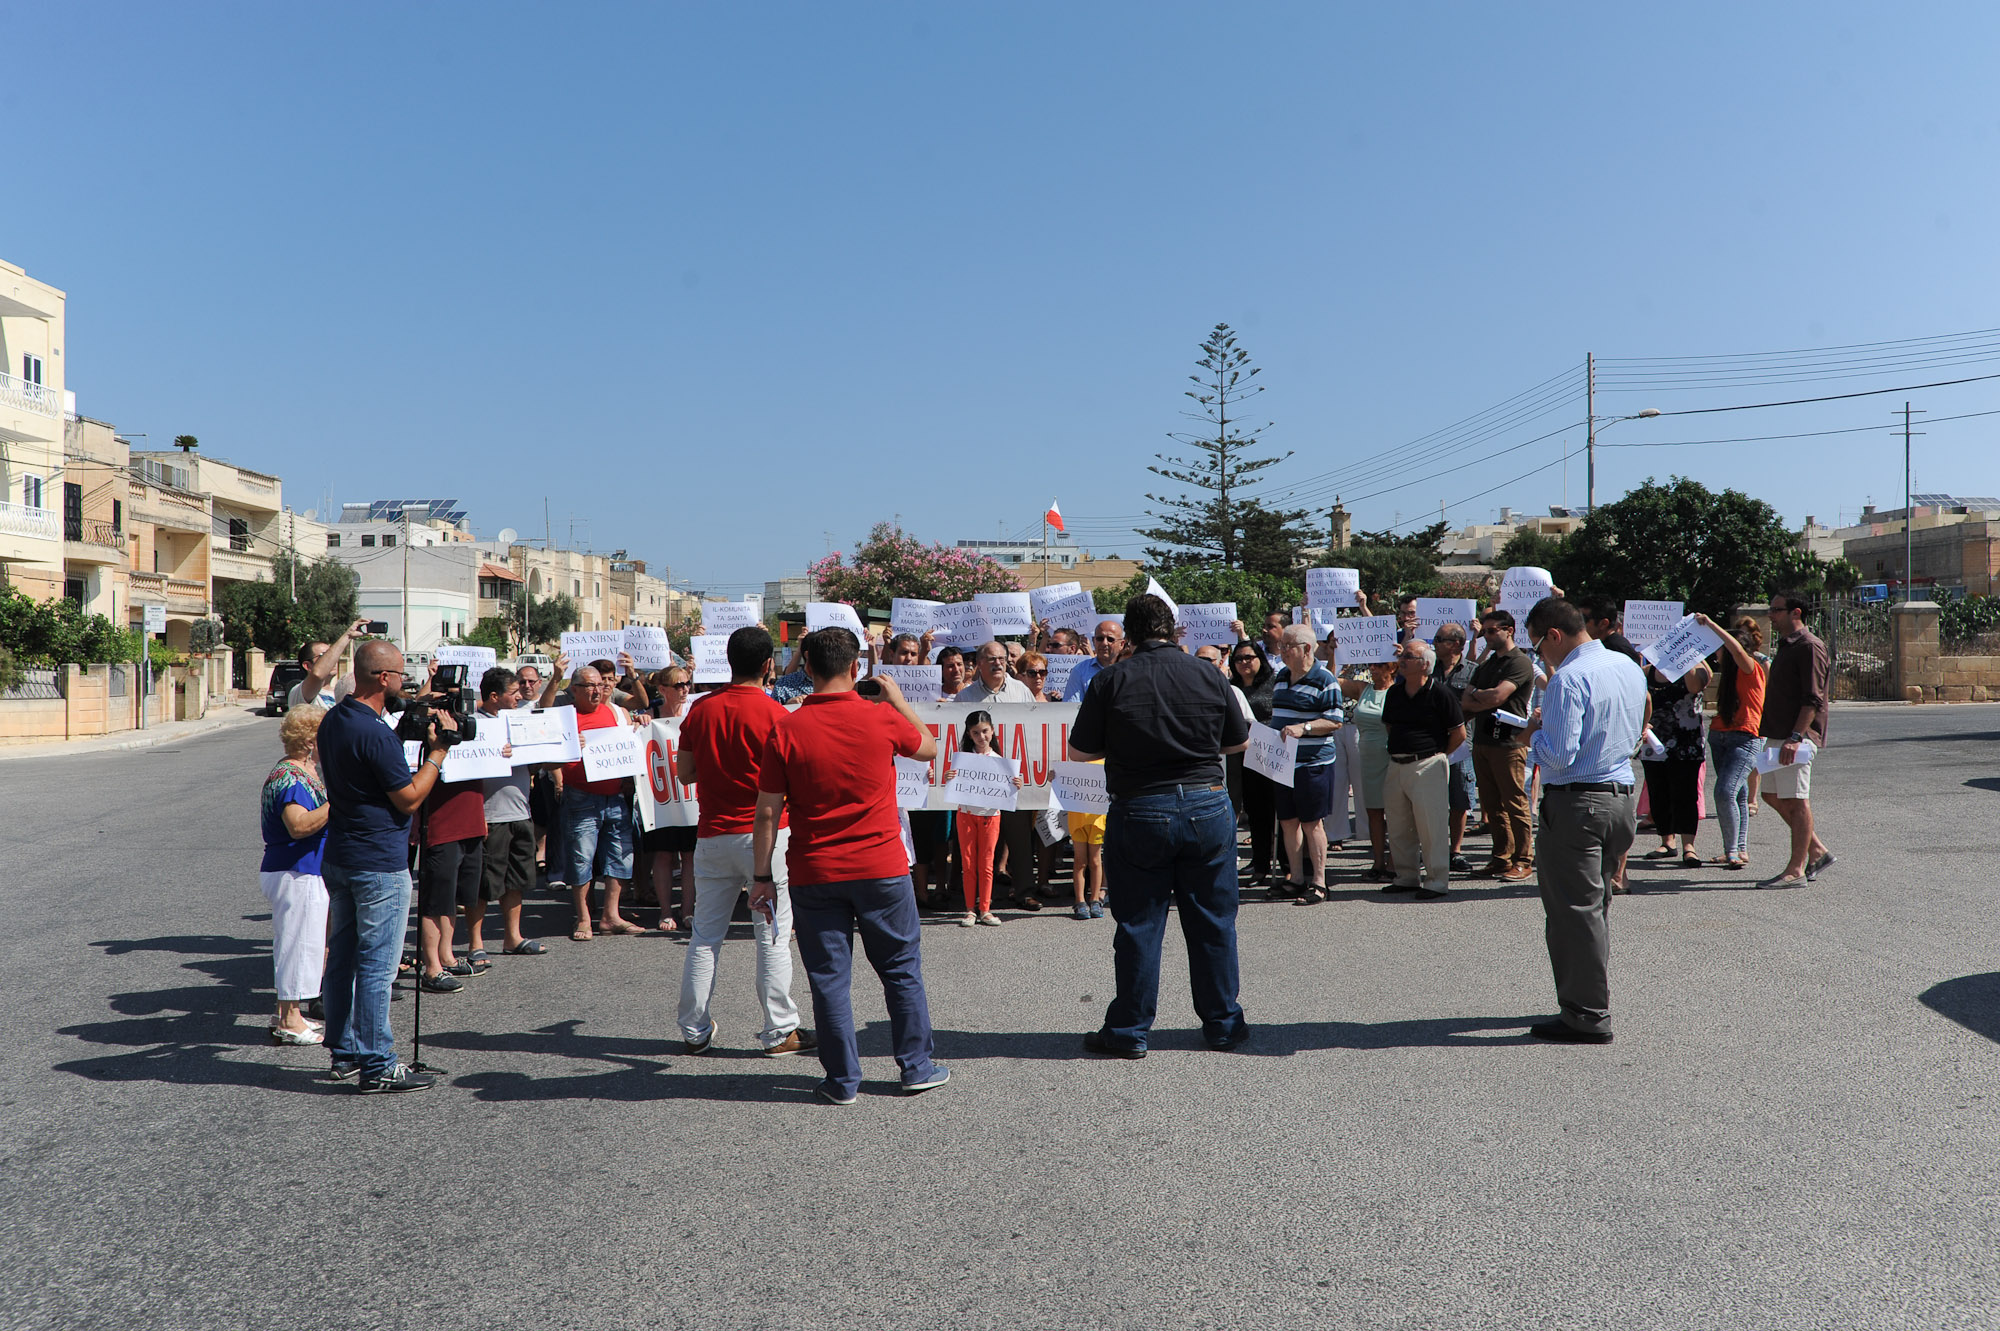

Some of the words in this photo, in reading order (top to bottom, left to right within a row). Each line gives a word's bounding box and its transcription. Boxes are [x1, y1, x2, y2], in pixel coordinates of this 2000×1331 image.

[1507, 591, 1544, 599] SQUARE
[1062, 594, 1088, 608] NIBNU
[933, 606, 960, 618] SAVE
[962, 605, 983, 615] OUR
[987, 606, 1025, 614] EQIRDUX
[932, 621, 959, 631] ONLY
[962, 618, 989, 628] OPEN
[1339, 622, 1364, 630] SAVE
[1367, 620, 1389, 628] OUR
[590, 635, 620, 643] NIBNU
[630, 630, 652, 638] SAVE
[946, 632, 978, 643] SPACE
[1194, 632, 1223, 640] SPACE
[1337, 635, 1363, 644] ONLY
[1366, 633, 1393, 642] OPEN
[1654, 621, 1688, 651] INSALVAW
[624, 642, 650, 651] ONLY
[1664, 631, 1693, 655] L-UNIKA
[567, 647, 620, 657] FIT-TRIQAT
[1350, 648, 1381, 657] SPACE
[1669, 642, 1696, 663] PJAZZA
[634, 656, 661, 664] SPACE
[898, 683, 936, 692] TRIQAT
[589, 744, 613, 754] SAVE
[616, 741, 636, 750] OUR
[1253, 738, 1274, 753] SAVE
[1276, 748, 1290, 760] OUR
[596, 756, 634, 769] SQUARE
[1256, 753, 1283, 773] SQUARE
[957, 768, 1012, 784] TEQIRDUX
[1060, 776, 1106, 788] TEQIRDU
[955, 783, 1008, 798] IL-PJAZZA
